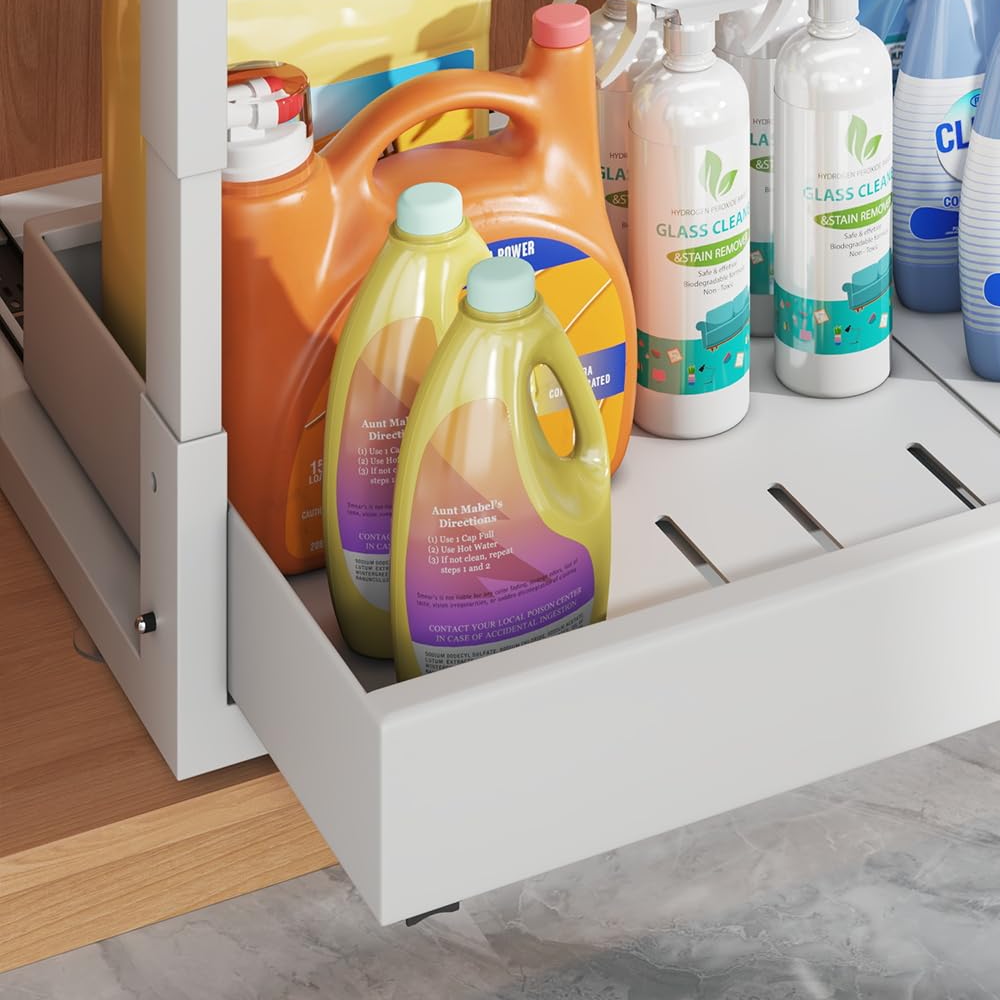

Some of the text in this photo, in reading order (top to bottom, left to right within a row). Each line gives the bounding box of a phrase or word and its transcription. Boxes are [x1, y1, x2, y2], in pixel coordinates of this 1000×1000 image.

[803, 186, 855, 202] GLASS
[821, 213, 858, 226] &STAIN
[656, 223, 708, 239] GLASS
[673, 250, 712, 263] &STAIN
[361, 419, 386, 429] Aunt
[357, 457, 368, 465] (2)
[358, 467, 369, 476] (3)
[370, 478, 390, 486] steps
[432, 499, 503, 516] Aunt Mabel's
[439, 515, 497, 528] Directions
[427, 535, 438, 544] (1)
[461, 534, 477, 543] Cap
[479, 530, 495, 539] Full
[428, 545, 439, 554] (2)
[457, 545, 472, 553] Hot
[474, 541, 498, 551] Water
[428, 547, 513, 565] (3) If not clean, repeat
[441, 566, 461, 575] steps
[468, 563, 484, 572] and
[428, 587, 583, 633] CONTACT YOUR LOCAL POISON CENTER
[436, 600, 577, 642] IN CASE OF ACCIDENTAL INGESTION
